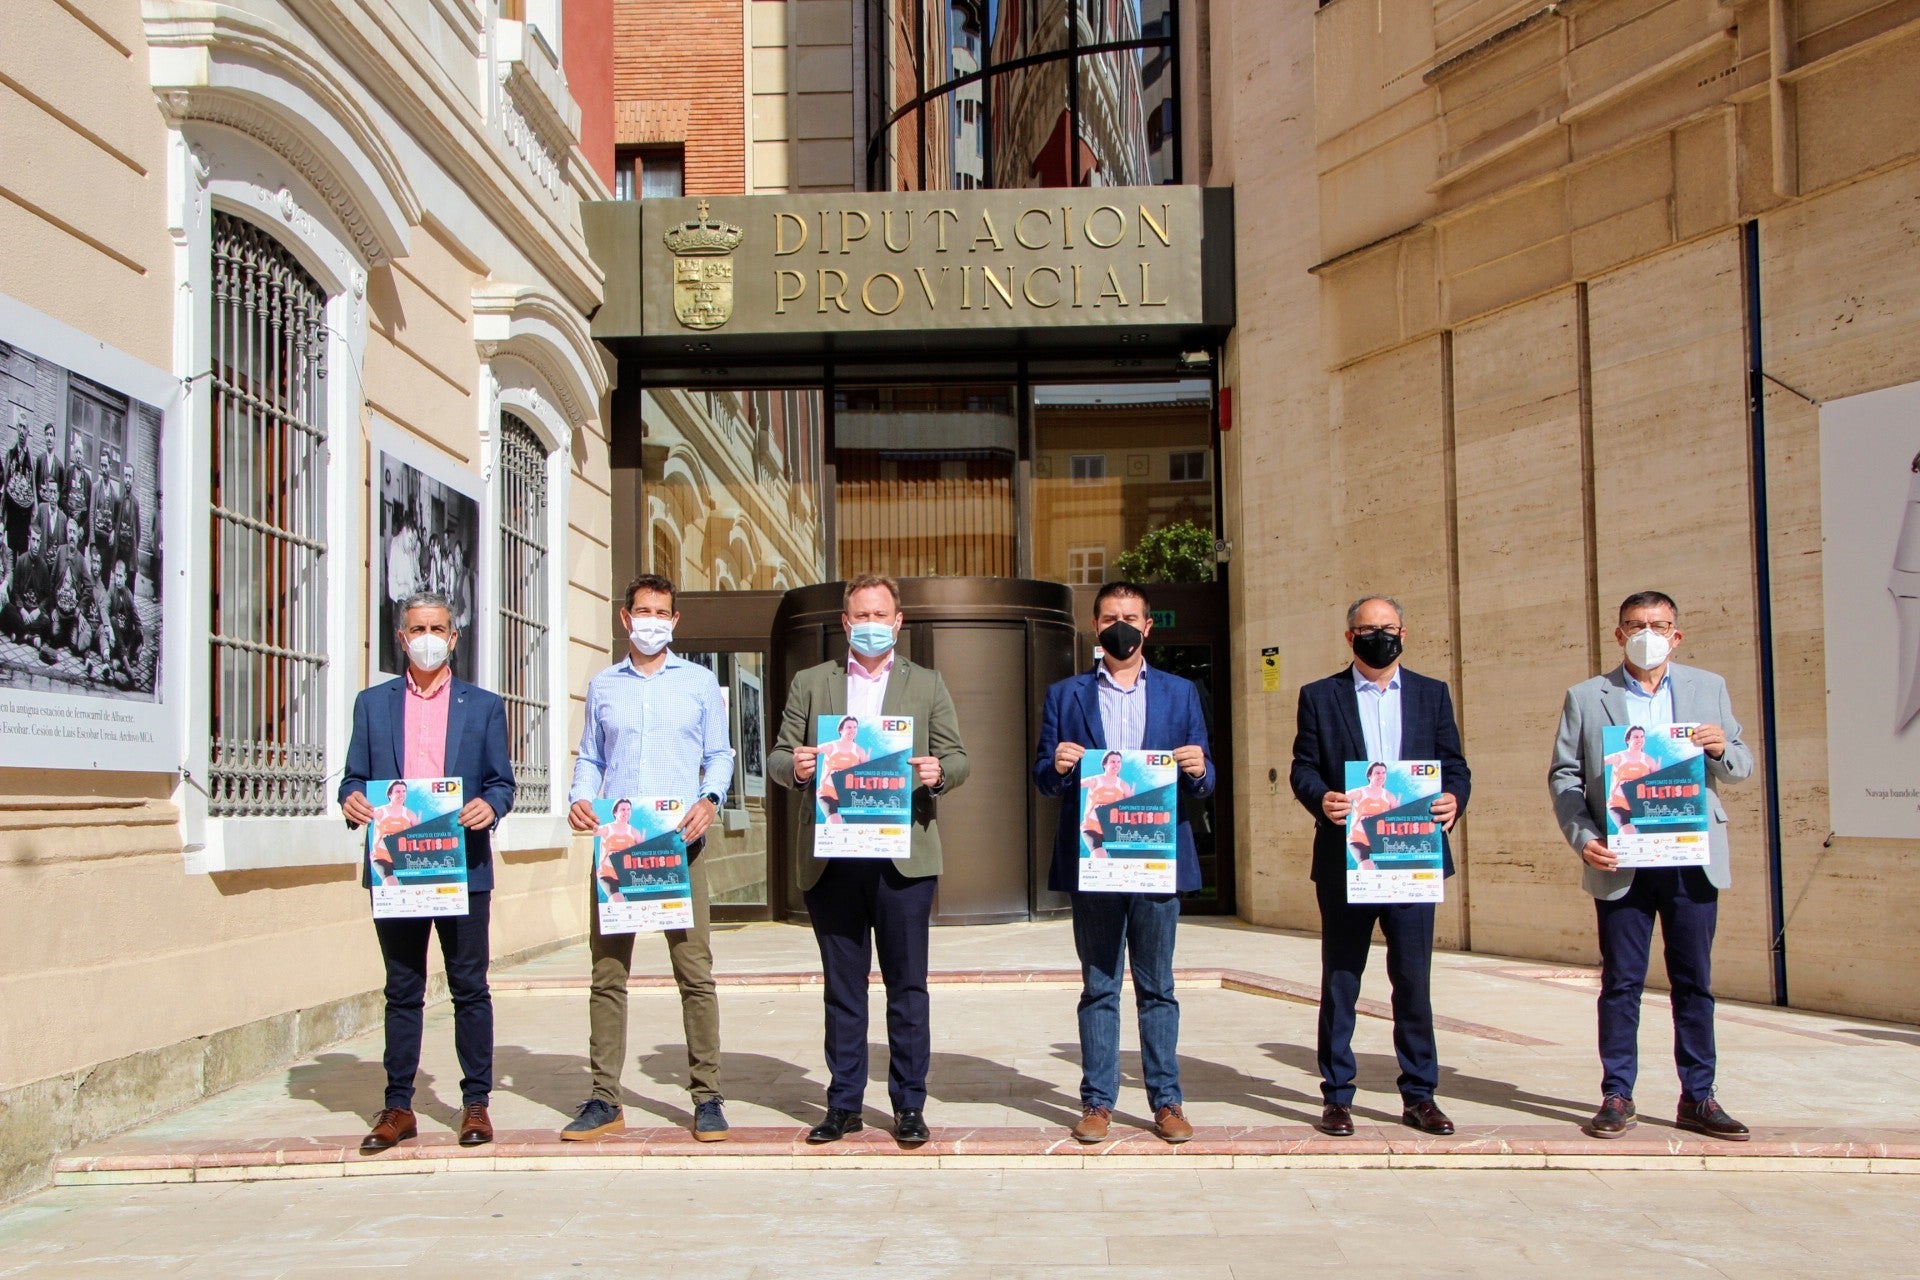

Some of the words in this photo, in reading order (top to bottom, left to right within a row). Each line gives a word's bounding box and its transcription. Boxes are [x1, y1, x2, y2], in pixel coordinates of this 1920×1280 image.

[773, 203, 1170, 256] DIPUTACION
[774, 262, 1170, 316] PROVINCIAL
[16, 704, 40, 718] antigua
[40, 706, 64, 718] estación
[66, 707, 72, 718] de
[32, 724, 54, 736] Cesión
[54, 726, 61, 737] de
[62, 726, 76, 738] Luis
[1866, 788, 1888, 800] Navaja
[1890, 788, 1920, 798] bandole
